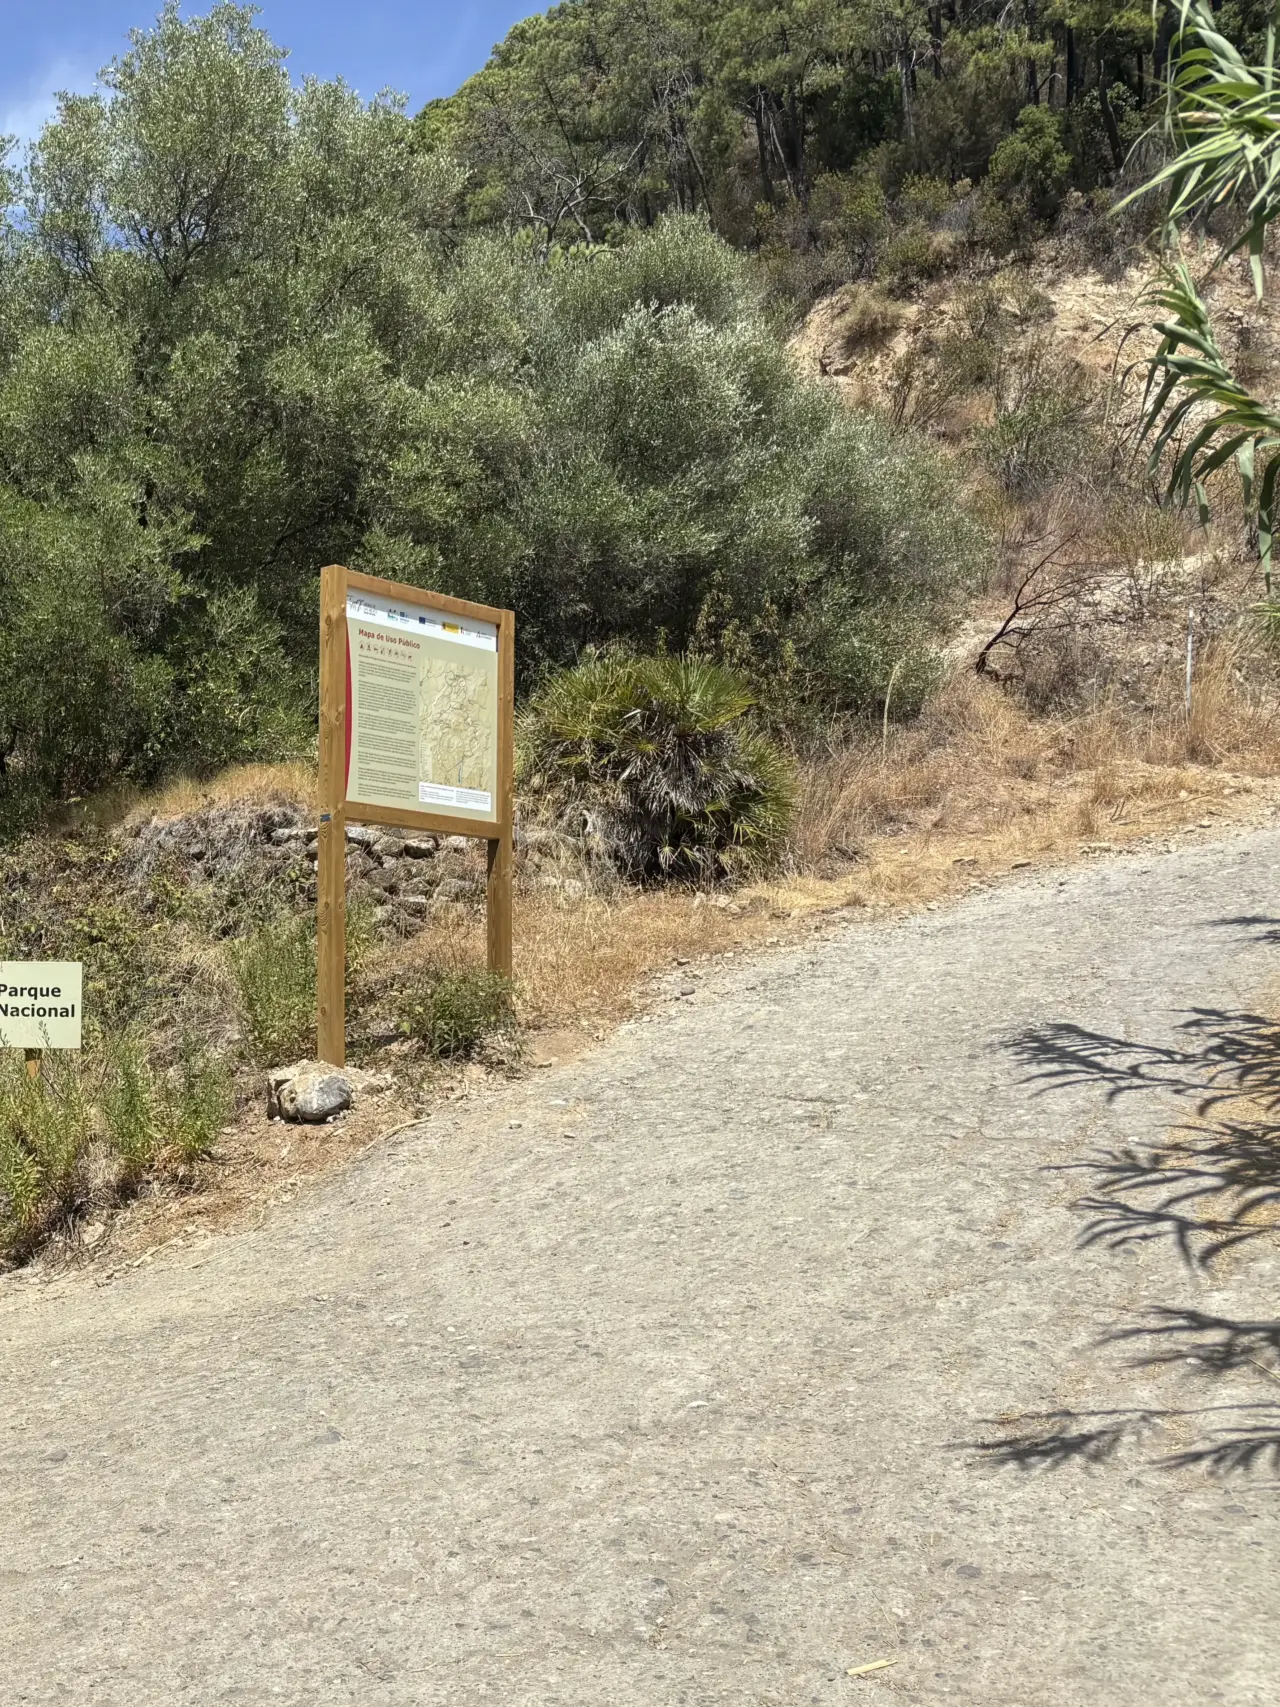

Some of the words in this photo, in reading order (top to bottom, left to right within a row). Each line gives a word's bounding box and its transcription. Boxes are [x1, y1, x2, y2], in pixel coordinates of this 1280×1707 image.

[358, 628, 375, 639] Mapa
[376, 633, 384, 641] de
[386, 635, 397, 644] Uso
[398, 637, 420, 649] Público
